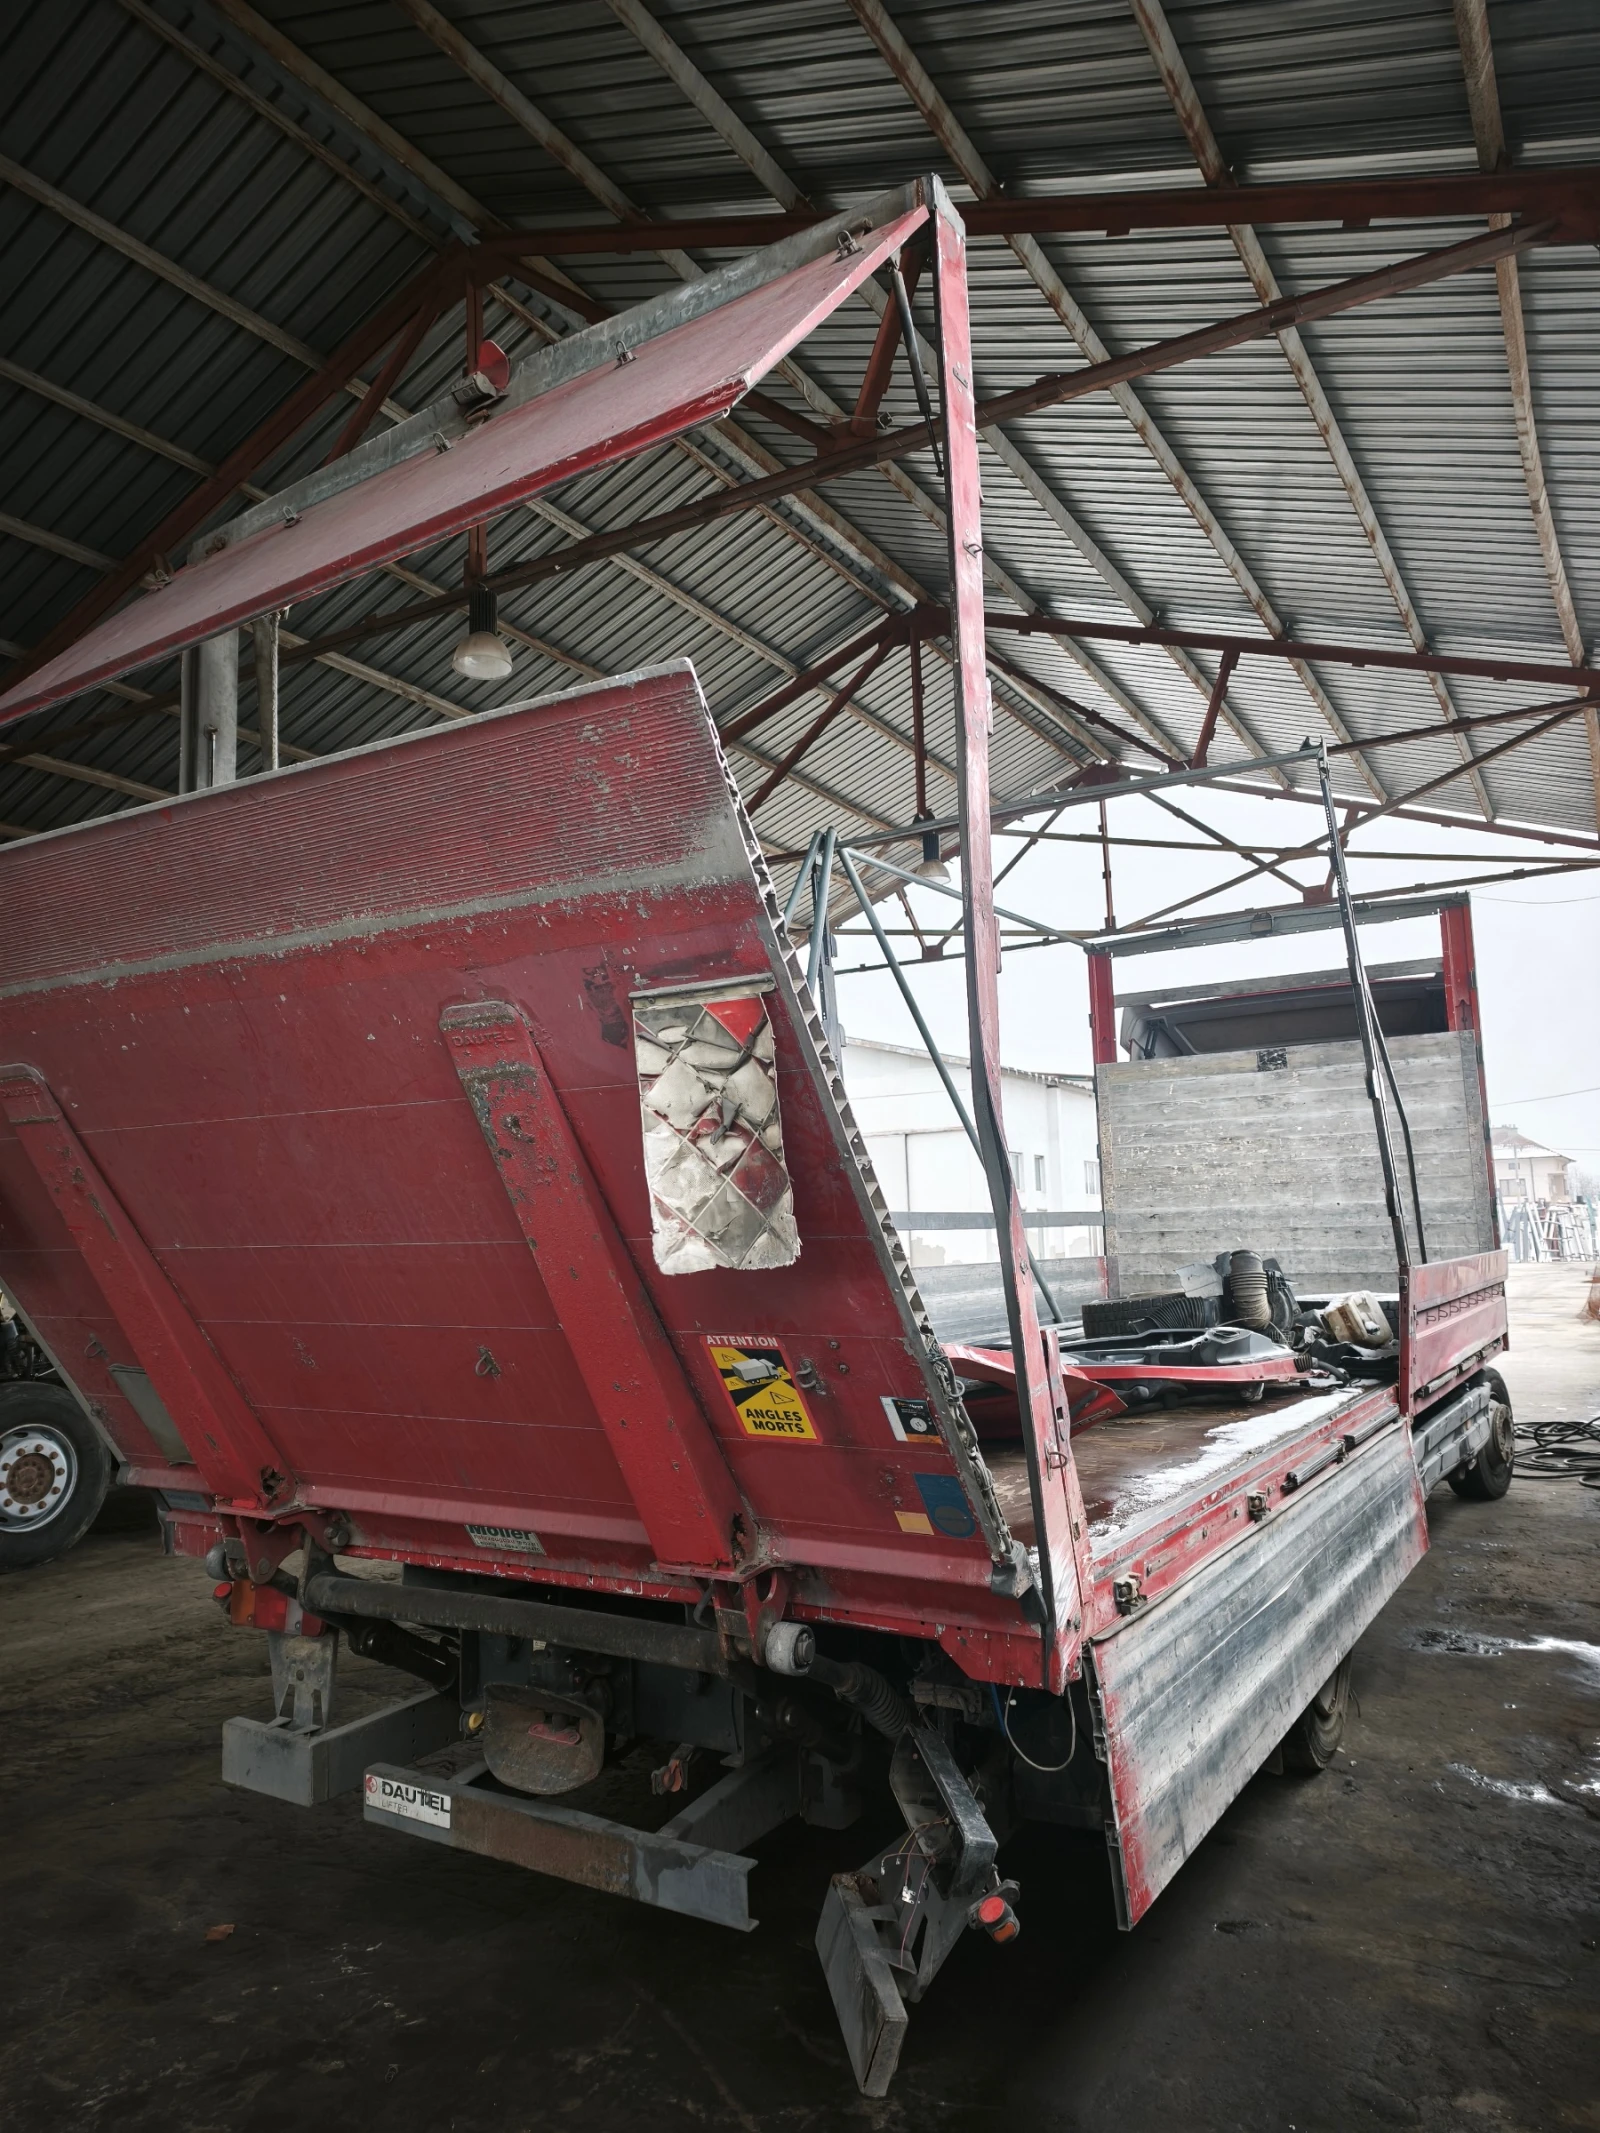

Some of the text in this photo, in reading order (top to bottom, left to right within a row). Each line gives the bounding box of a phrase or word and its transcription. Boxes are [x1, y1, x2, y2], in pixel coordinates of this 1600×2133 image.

[707, 1335, 778, 1347] ATTENTION
[746, 1409, 802, 1421] ANGLES
[753, 1420, 805, 1433] MORTS
[382, 1780, 451, 1814] DAUTEL
[382, 1799, 408, 1814] LIFTER
